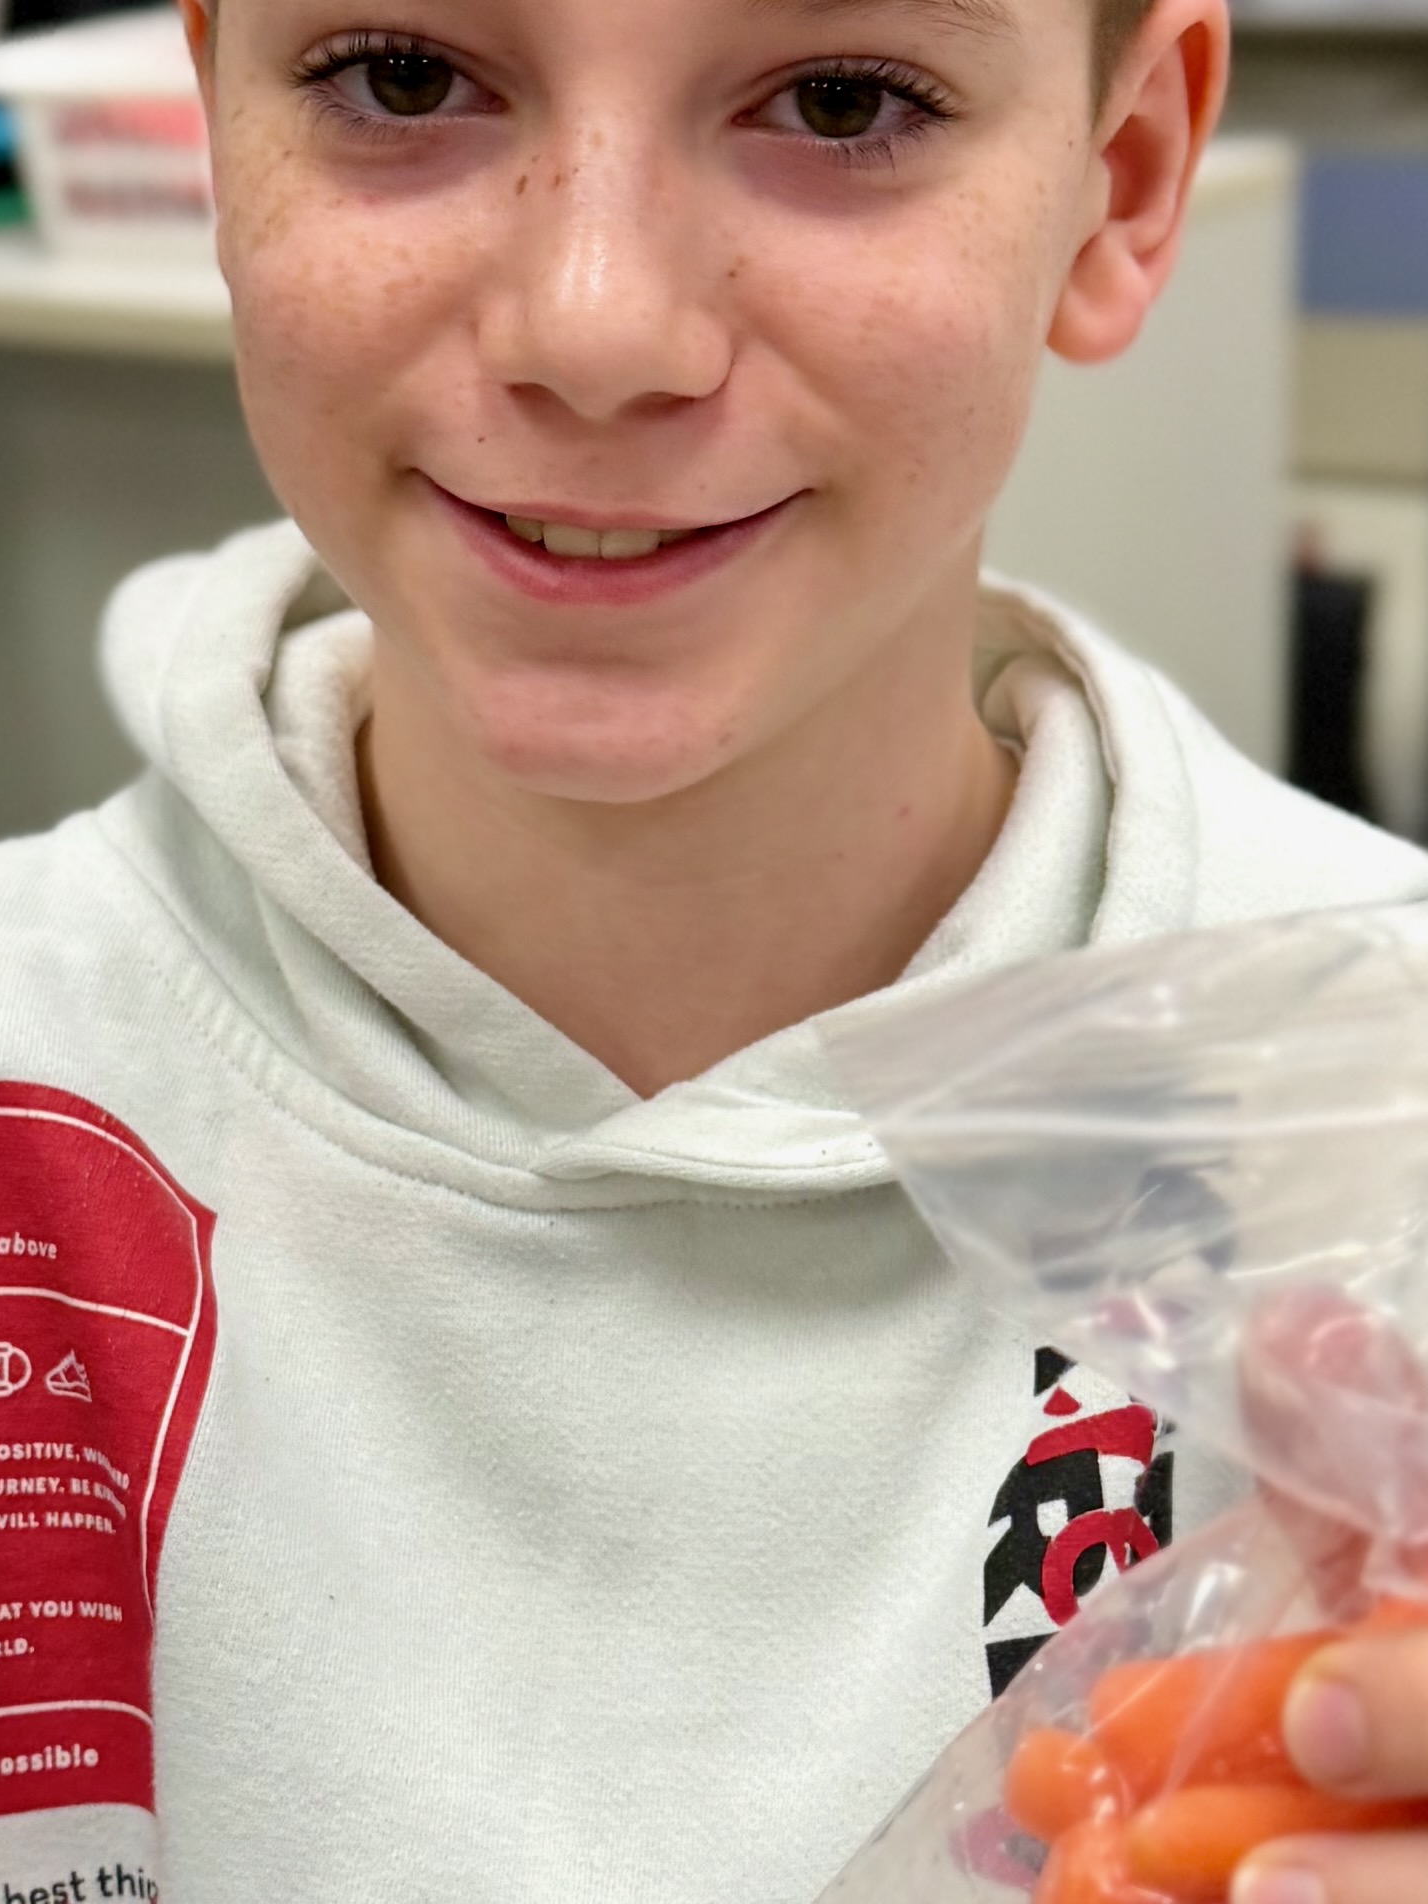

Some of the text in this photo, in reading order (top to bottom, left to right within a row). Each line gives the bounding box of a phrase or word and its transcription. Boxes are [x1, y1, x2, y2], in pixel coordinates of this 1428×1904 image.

[70, 1478, 91, 1496] BE
[28, 1600, 74, 1617] YOU
[78, 1601, 123, 1623] WISH
